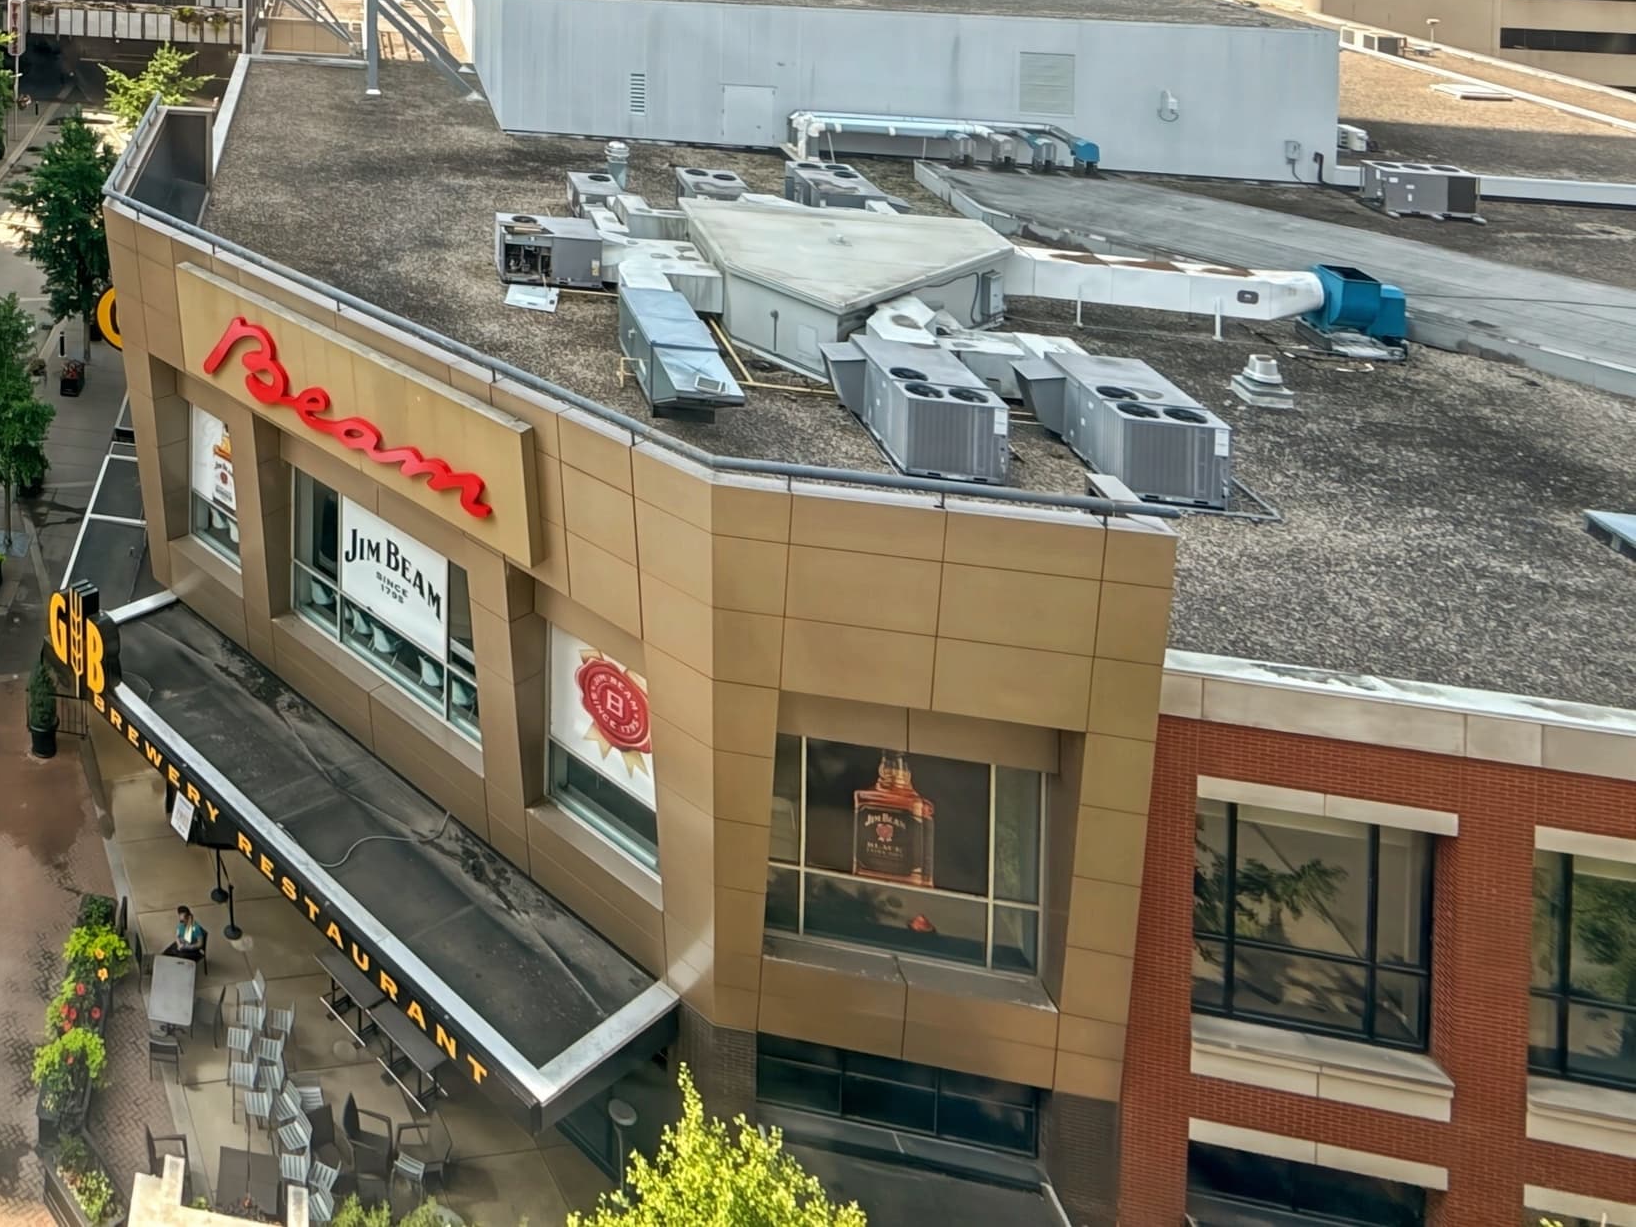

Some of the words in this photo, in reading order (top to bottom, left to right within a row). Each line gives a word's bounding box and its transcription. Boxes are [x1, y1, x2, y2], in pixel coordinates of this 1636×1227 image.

[202, 316, 494, 518] Beam
[345, 528, 381, 563] JIM
[386, 538, 442, 622] BEAM
[376, 571, 408, 598] SINCE
[48, 595, 69, 666] G
[86, 615, 105, 694] B
[94, 694, 219, 823] BREWERY
[238, 831, 488, 1085] RESTAURANT
